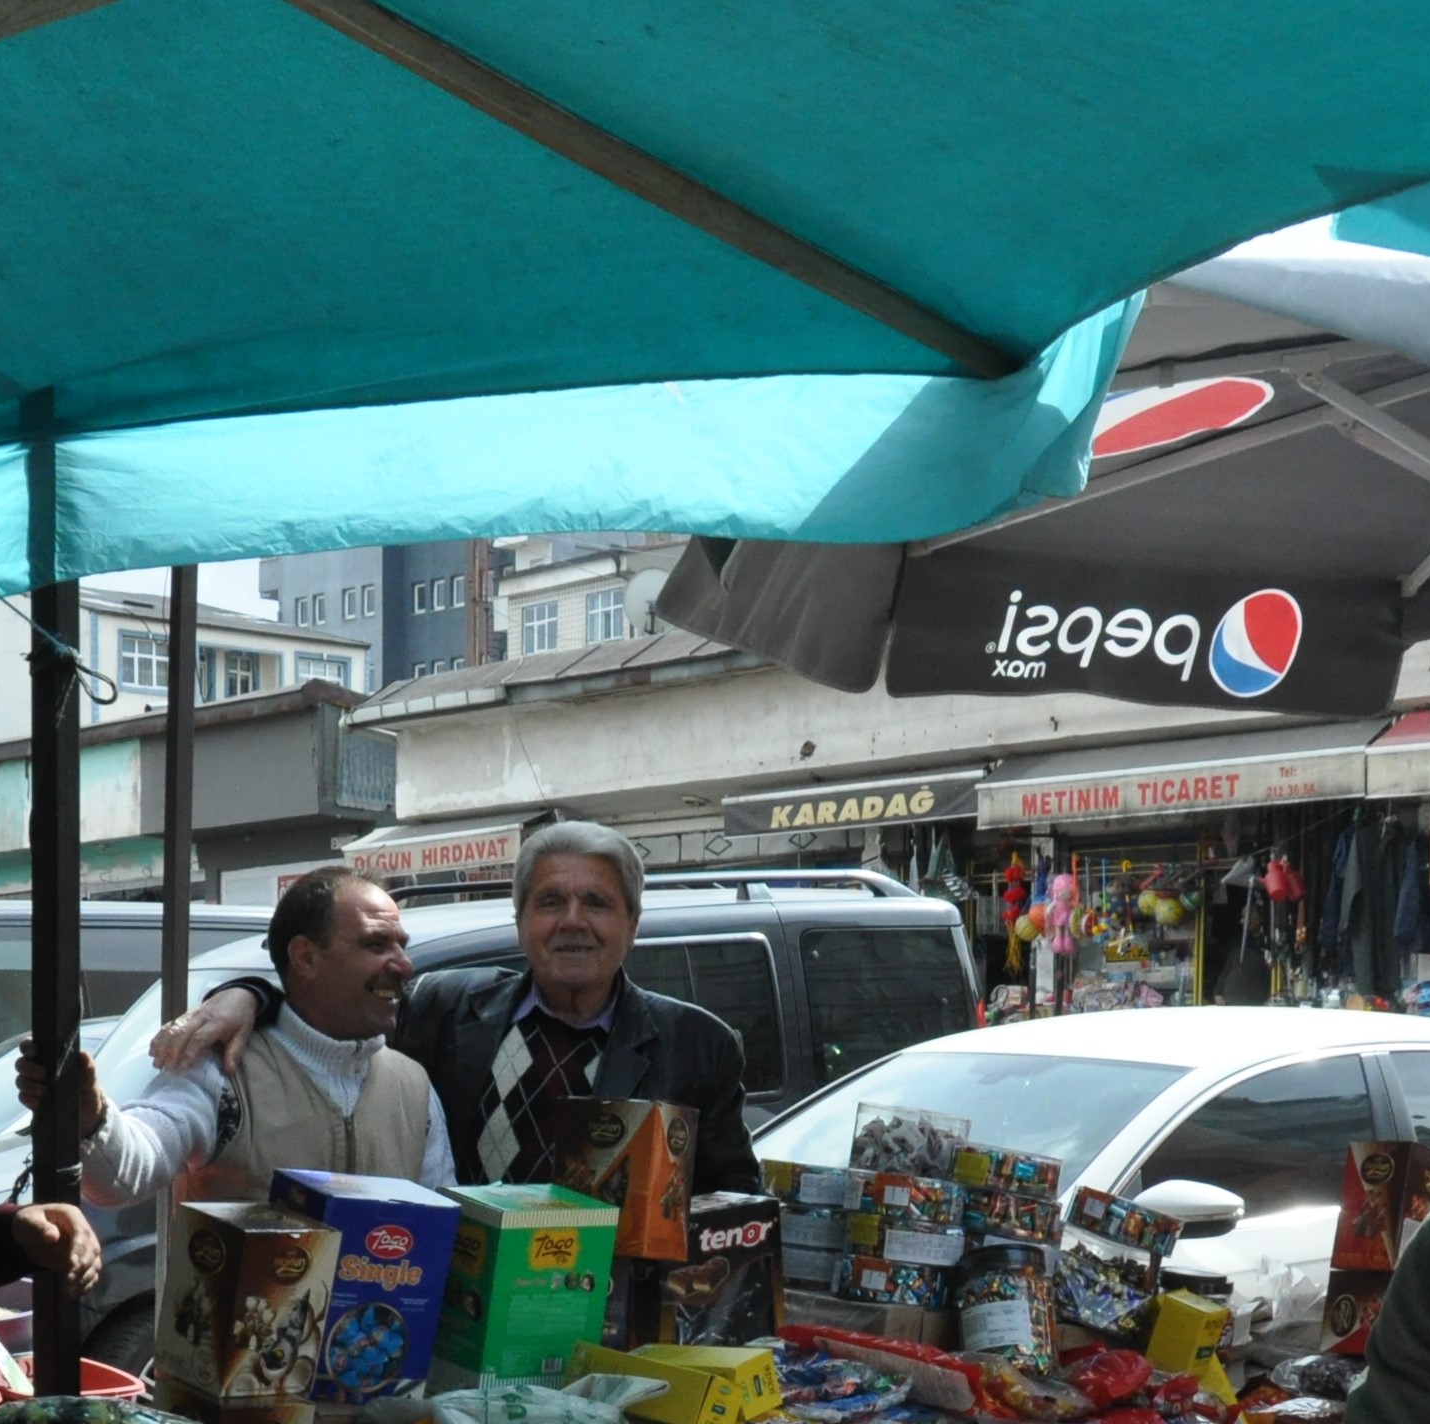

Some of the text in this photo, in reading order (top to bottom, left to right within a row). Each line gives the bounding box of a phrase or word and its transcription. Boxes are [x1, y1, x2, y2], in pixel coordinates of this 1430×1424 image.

[1279, 766, 1298, 779] Tel:
[770, 785, 936, 830] KARADAĞ
[1021, 773, 1240, 817] METİNİM TİCARET
[421, 838, 510, 867] HIRDAVAT
[699, 1220, 775, 1252] tenor
[338, 1254, 424, 1292] Single
